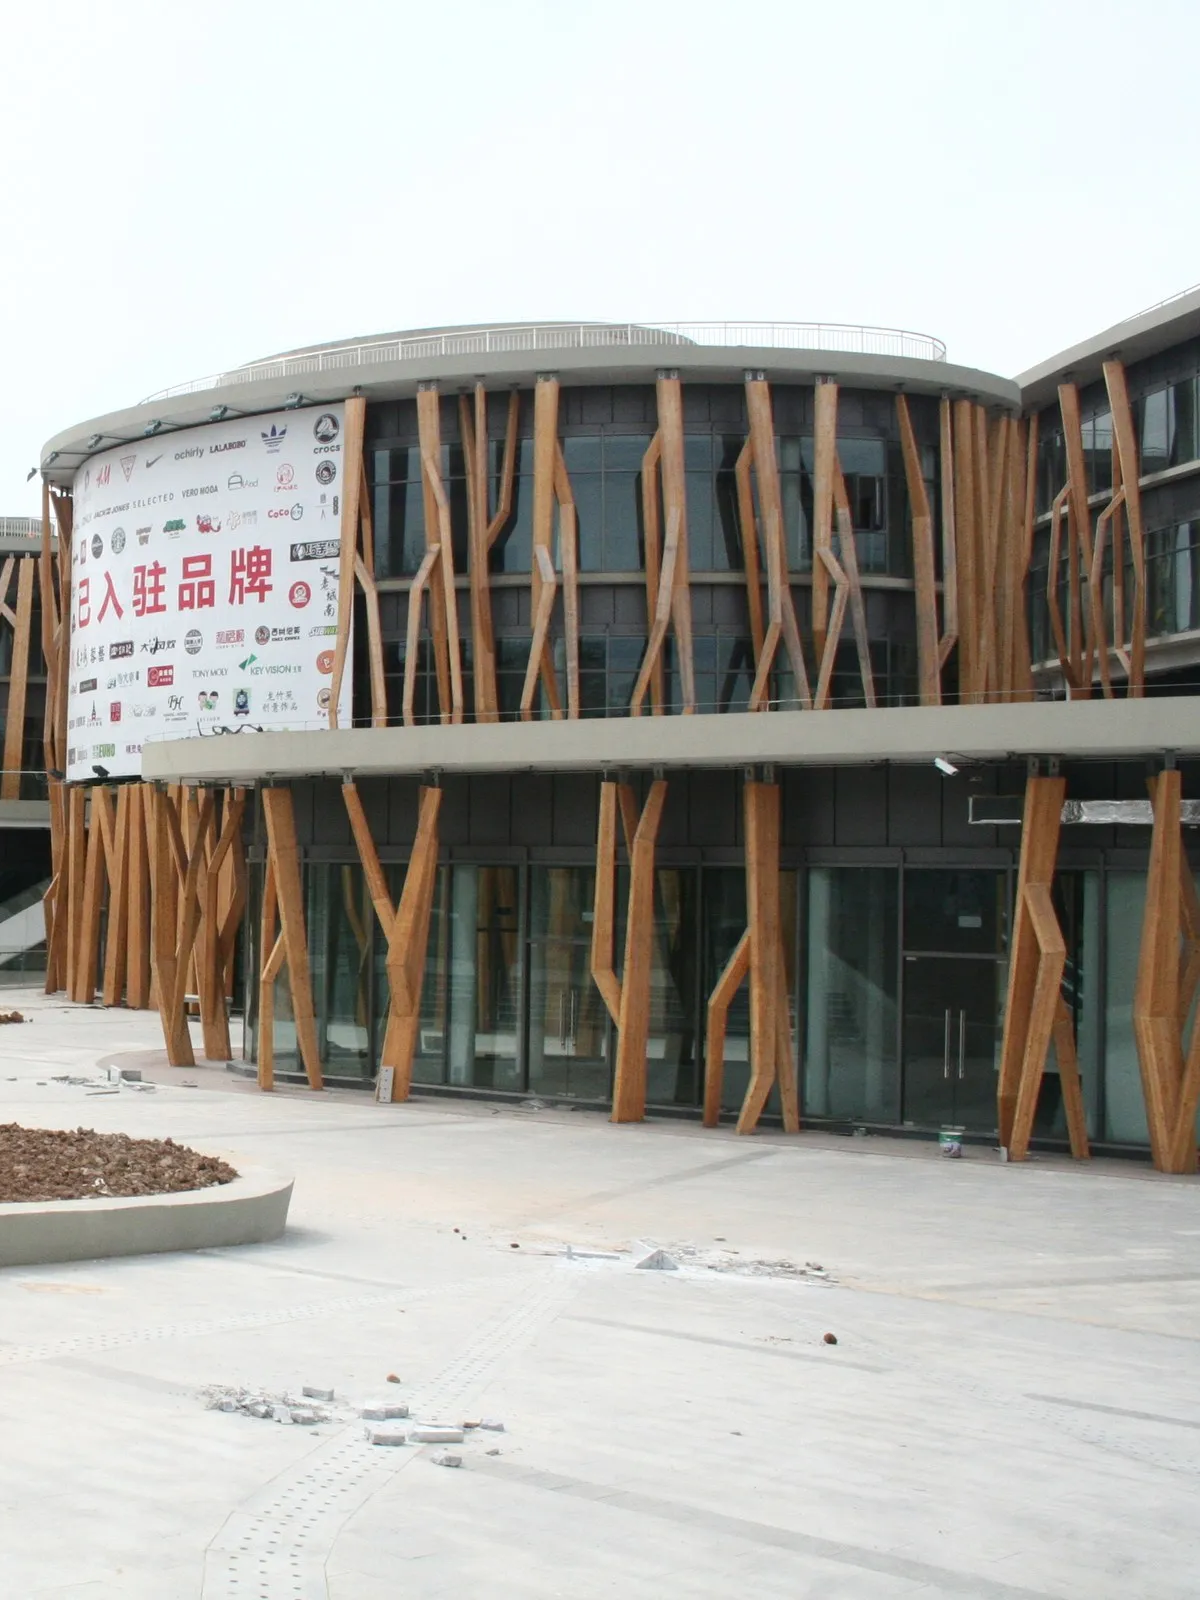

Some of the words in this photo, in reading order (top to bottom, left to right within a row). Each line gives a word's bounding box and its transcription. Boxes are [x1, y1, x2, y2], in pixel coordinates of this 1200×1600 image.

[209, 440, 246, 454] LALABOBO
[313, 444, 340, 455] crocs
[174, 446, 204, 461] ochirly
[181, 487, 199, 498] VERO
[132, 492, 175, 508] SELECTED
[78, 544, 274, 630] 已入驻品牌
[192, 669, 210, 678] TONY
[210, 667, 228, 677] MOLY
[250, 666, 264, 675] KEY
[265, 664, 291, 674] VISION
